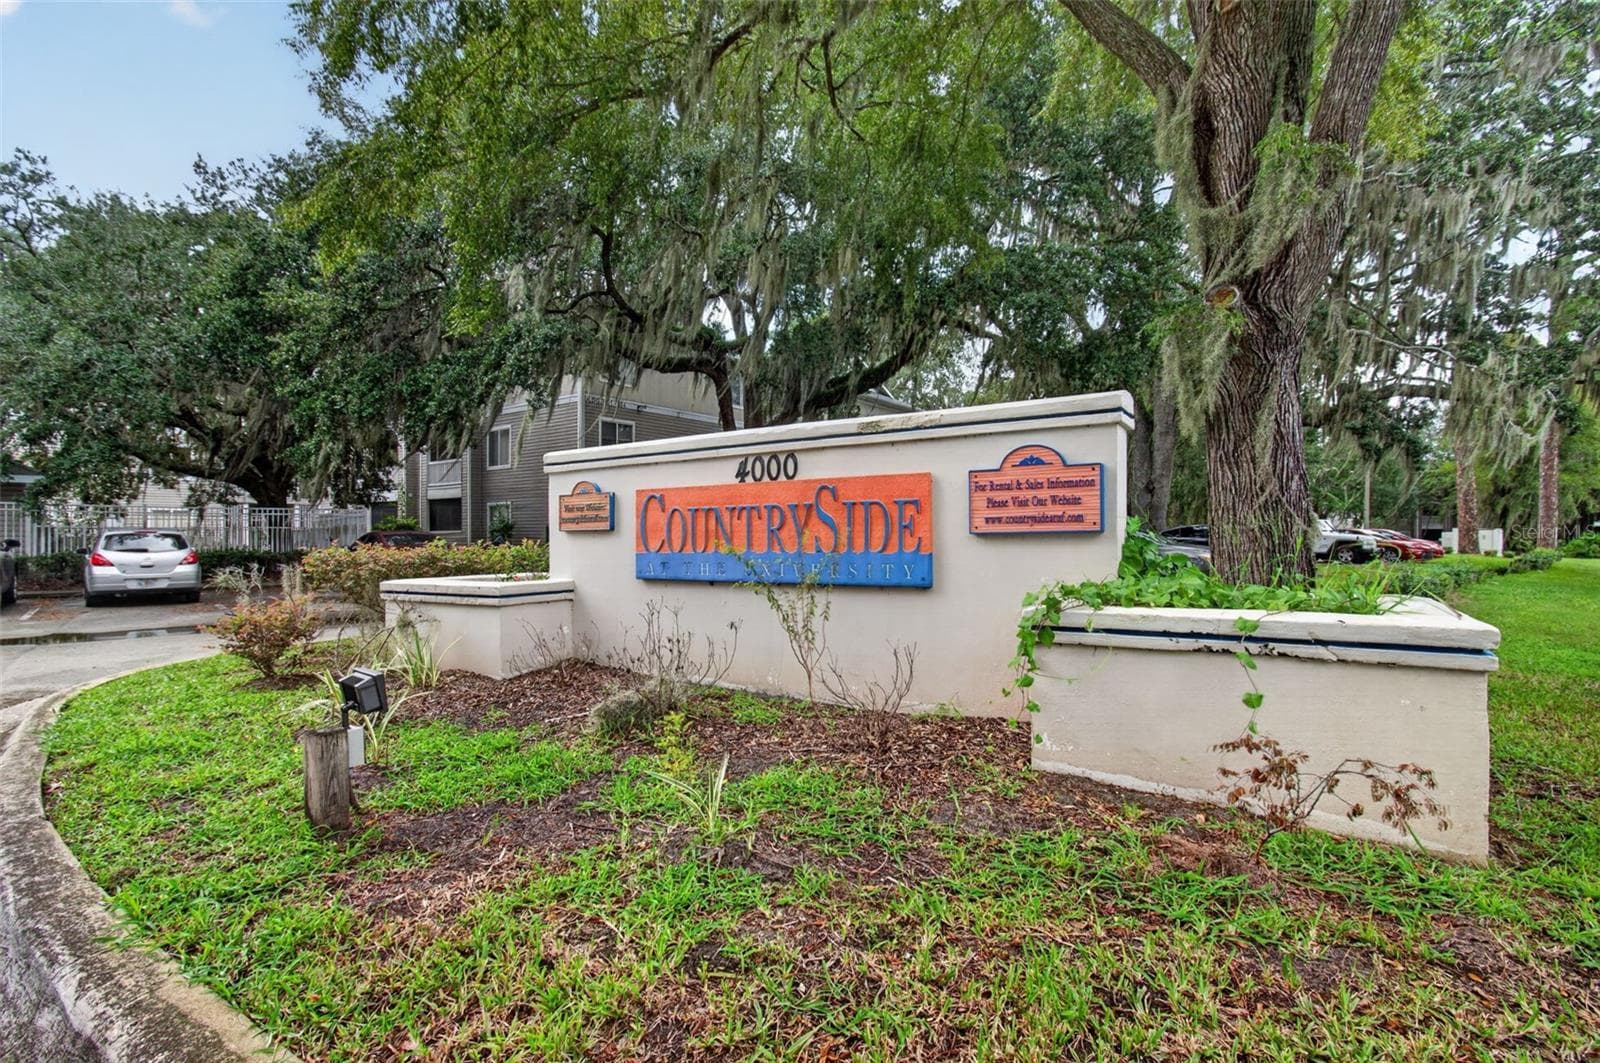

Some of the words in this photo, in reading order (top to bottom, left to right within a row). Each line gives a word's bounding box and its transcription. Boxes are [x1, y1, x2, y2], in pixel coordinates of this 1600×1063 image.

[735, 452, 799, 483] 4000
[974, 481, 987, 492] For
[989, 480, 1013, 491] Rental
[1016, 479, 1024, 490] &
[1025, 478, 1044, 490] Sales
[1047, 477, 1096, 489] Information
[986, 497, 1009, 508] Please
[1011, 496, 1029, 507] Visit
[1031, 495, 1047, 507] Our
[1050, 494, 1082, 506] Website
[646, 561, 670, 576] AT
[683, 560, 727, 577] THE
